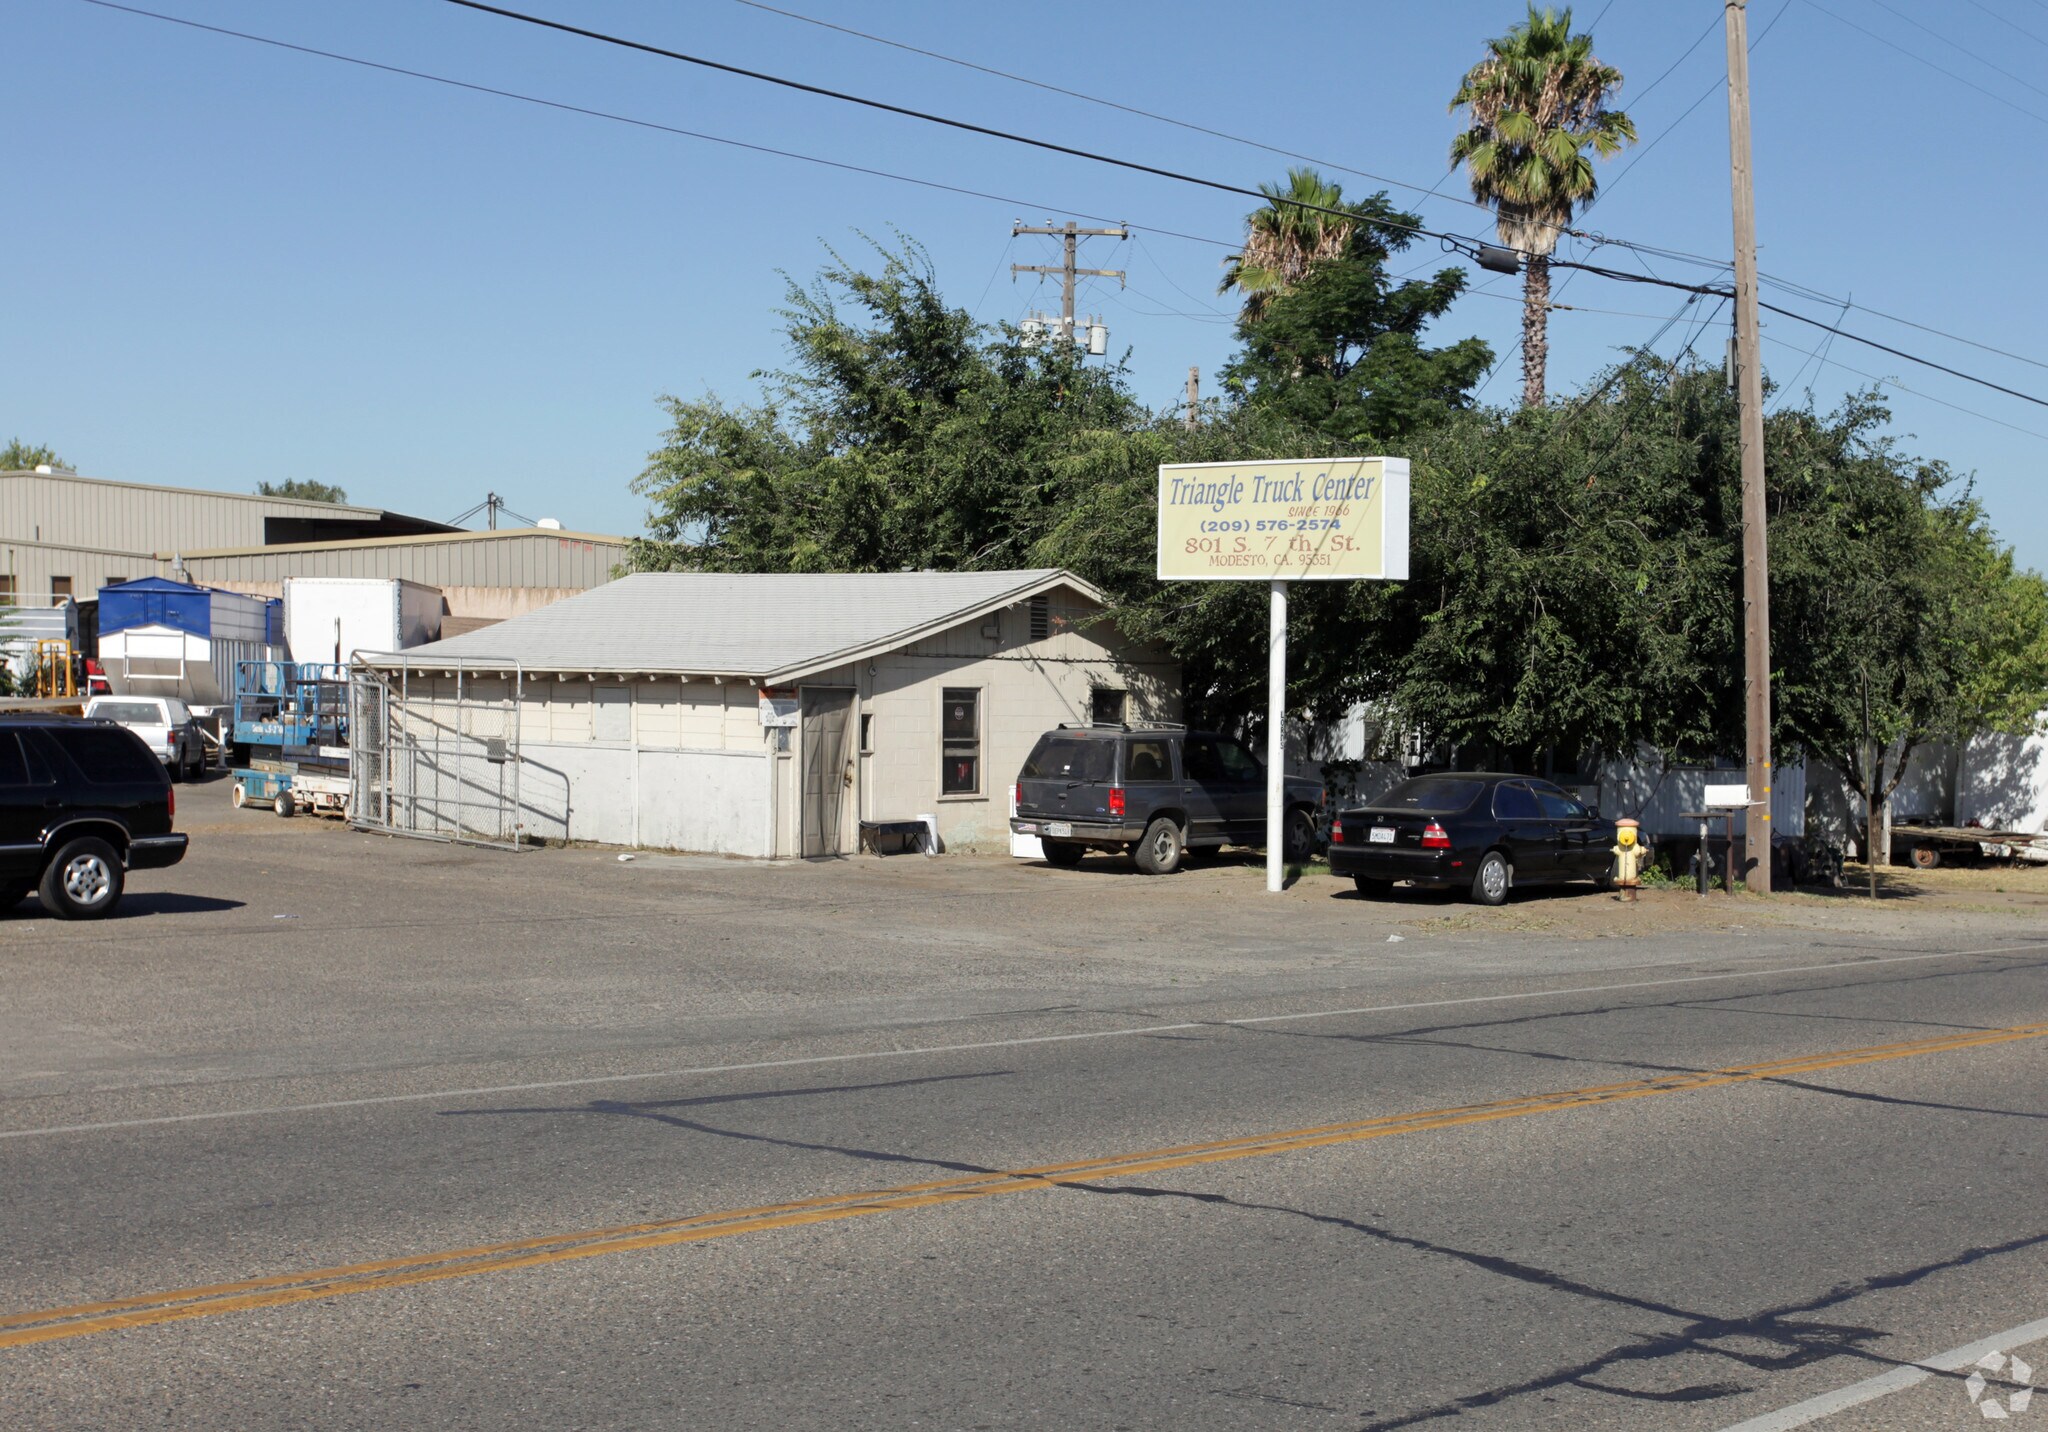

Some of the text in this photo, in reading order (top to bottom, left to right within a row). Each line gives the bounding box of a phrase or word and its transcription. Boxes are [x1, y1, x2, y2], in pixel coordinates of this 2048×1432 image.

[1170, 471, 1375, 513] Triangle Truck Center
[1288, 504, 1350, 517] SINCE 1966
[1200, 519, 1341, 533] (209) 576-2574
[1185, 536, 1222, 554] 801
[1233, 536, 1251, 553] S.
[1330, 534, 1360, 552] St.
[1209, 554, 1268, 567] MODESTO,
[1273, 553, 1293, 567] CA.
